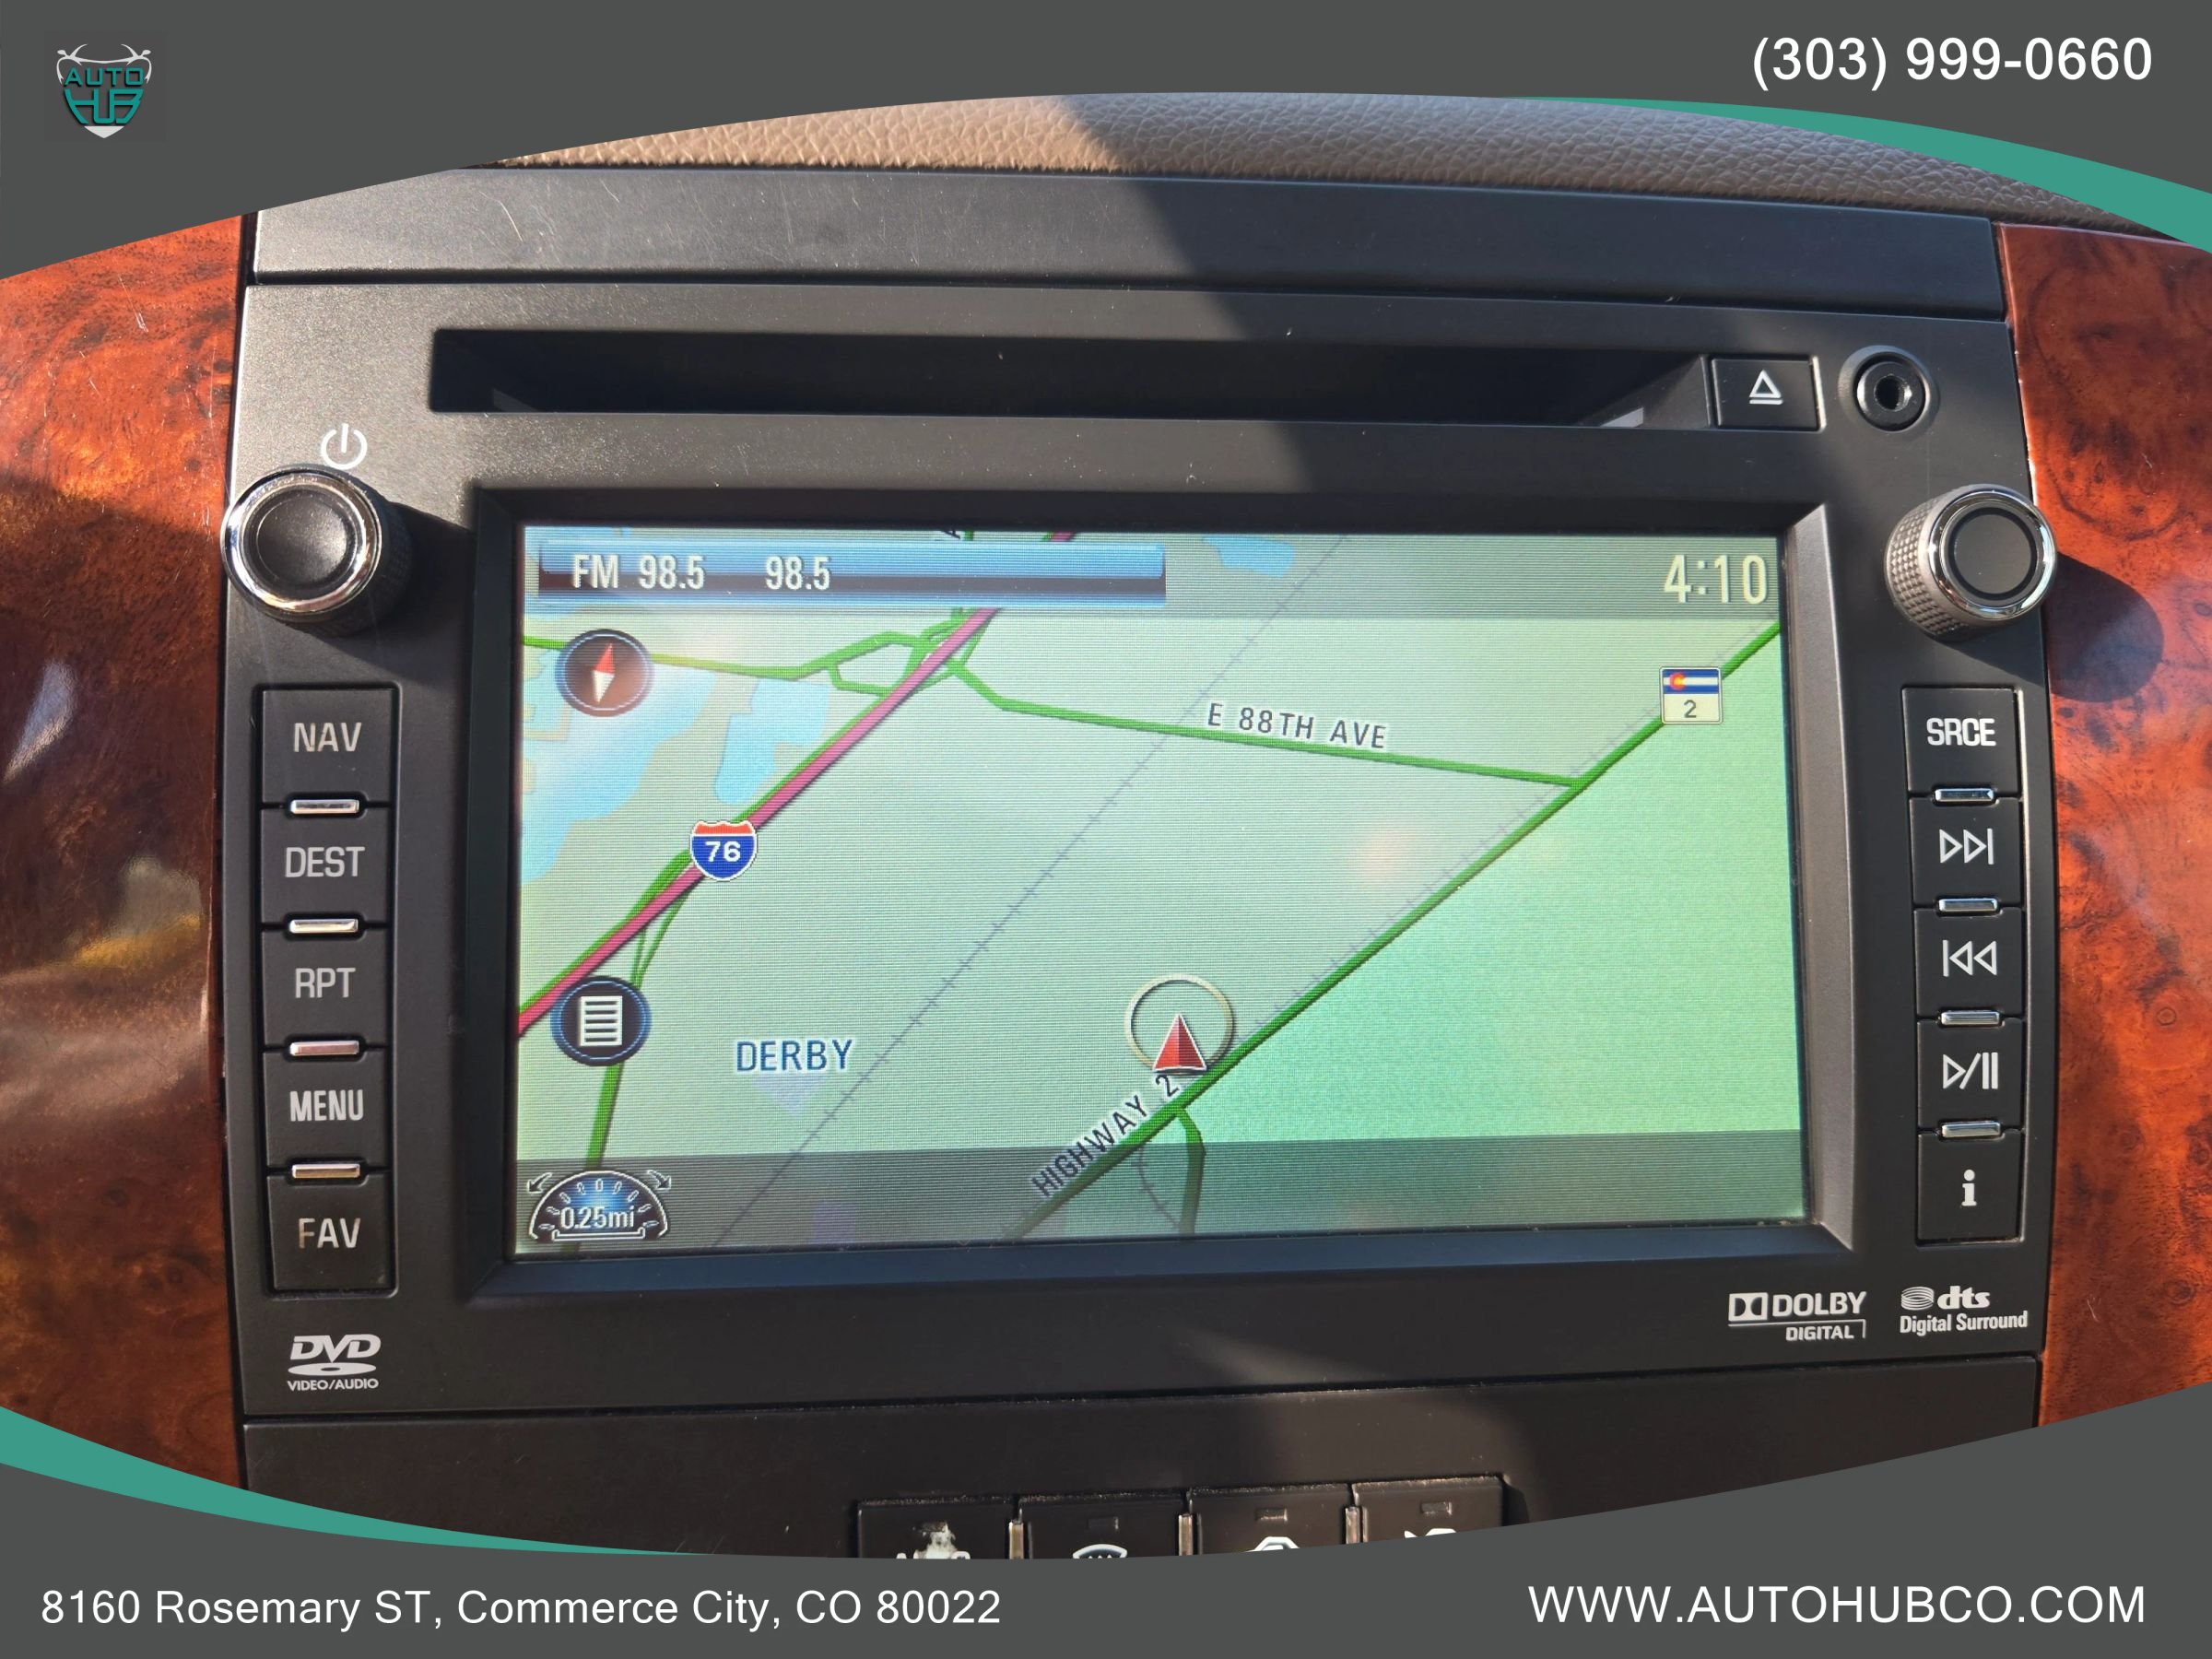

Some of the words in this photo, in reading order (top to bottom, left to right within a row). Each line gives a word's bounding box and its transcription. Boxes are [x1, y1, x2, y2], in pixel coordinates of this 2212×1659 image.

[571, 554, 619, 589] FM
[638, 555, 705, 590] 98.5
[764, 556, 830, 591] 98.5
[1664, 554, 1768, 605] 4:10
[1683, 699, 1697, 718] 2
[293, 722, 362, 753] NAV
[1207, 702, 1224, 726] E
[1239, 707, 1314, 739] 88TH
[1329, 719, 1386, 748] AVE
[1926, 717, 1997, 747] SRCE
[285, 846, 366, 878] DEST
[704, 841, 741, 863] 76
[295, 967, 357, 999] RPT
[736, 1039, 853, 1072] DERBY
[289, 1088, 364, 1123] MENU
[1031, 1094, 1147, 1197] HIGHWAY
[1155, 1074, 1180, 1098] 2
[299, 1218, 360, 1249] FAV
[1771, 1290, 1867, 1317] DOLBY
[1936, 1285, 1991, 1310] dts
[1785, 1324, 1855, 1342] DIGITAL
[1899, 1313, 1952, 1336] Digital
[1955, 1310, 2029, 1331] Surround
[289, 1334, 382, 1363] DVD
[287, 1378, 380, 1392] VIDEO/AUDIO
